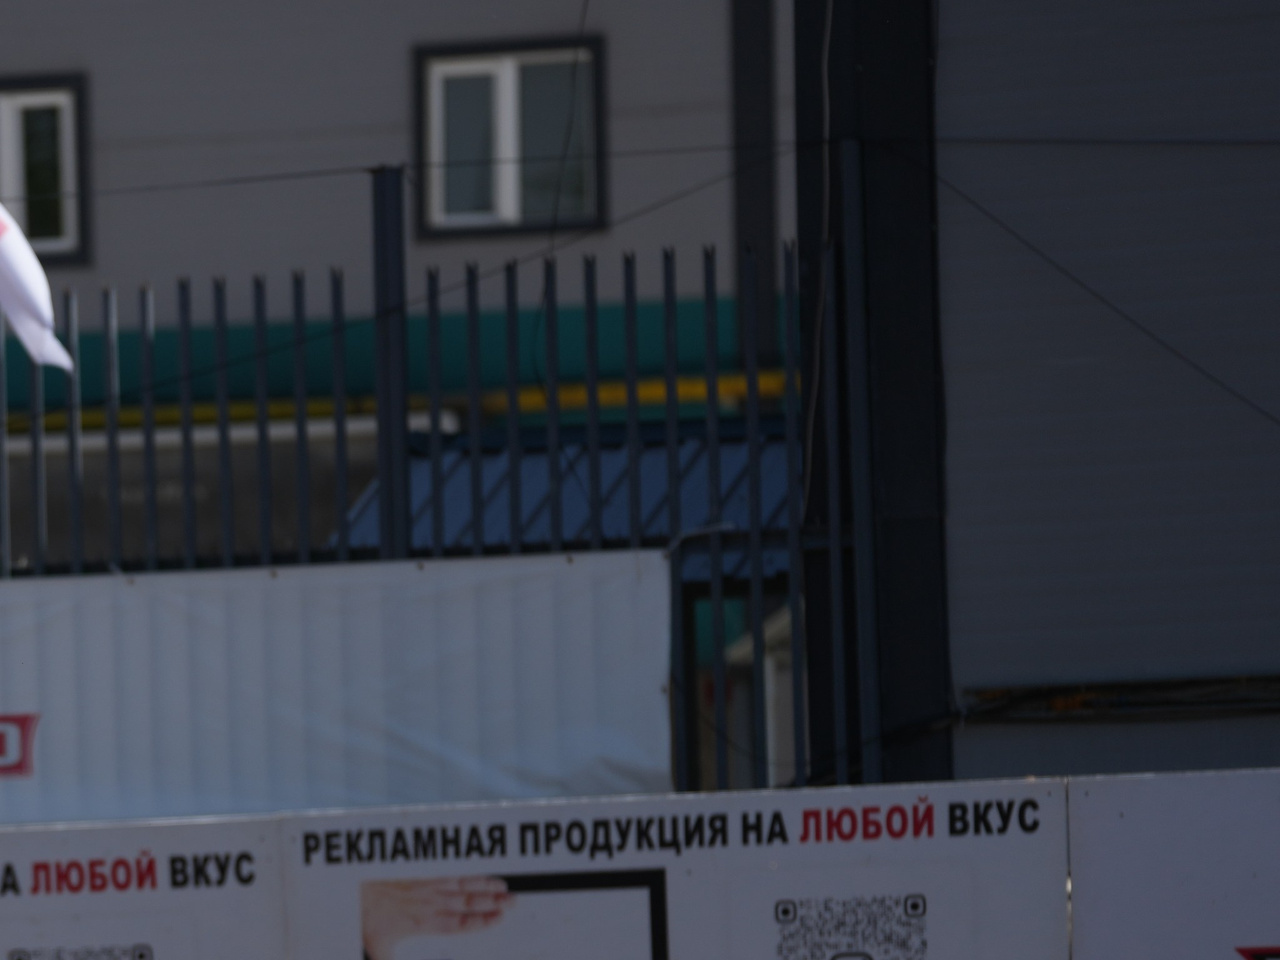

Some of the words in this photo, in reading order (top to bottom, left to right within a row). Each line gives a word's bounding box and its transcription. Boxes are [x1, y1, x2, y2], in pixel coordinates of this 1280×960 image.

[303, 825, 508, 865] РЕКЛАМНАЯ
[519, 813, 729, 859] ПРОДУКЦИЯ
[741, 810, 788, 846] НА
[799, 795, 935, 843] ЛЮБОЙ
[948, 799, 1040, 838] ВКУС
[31, 851, 159, 895] ЛЮБОЙ
[170, 851, 256, 889] ВКУС
